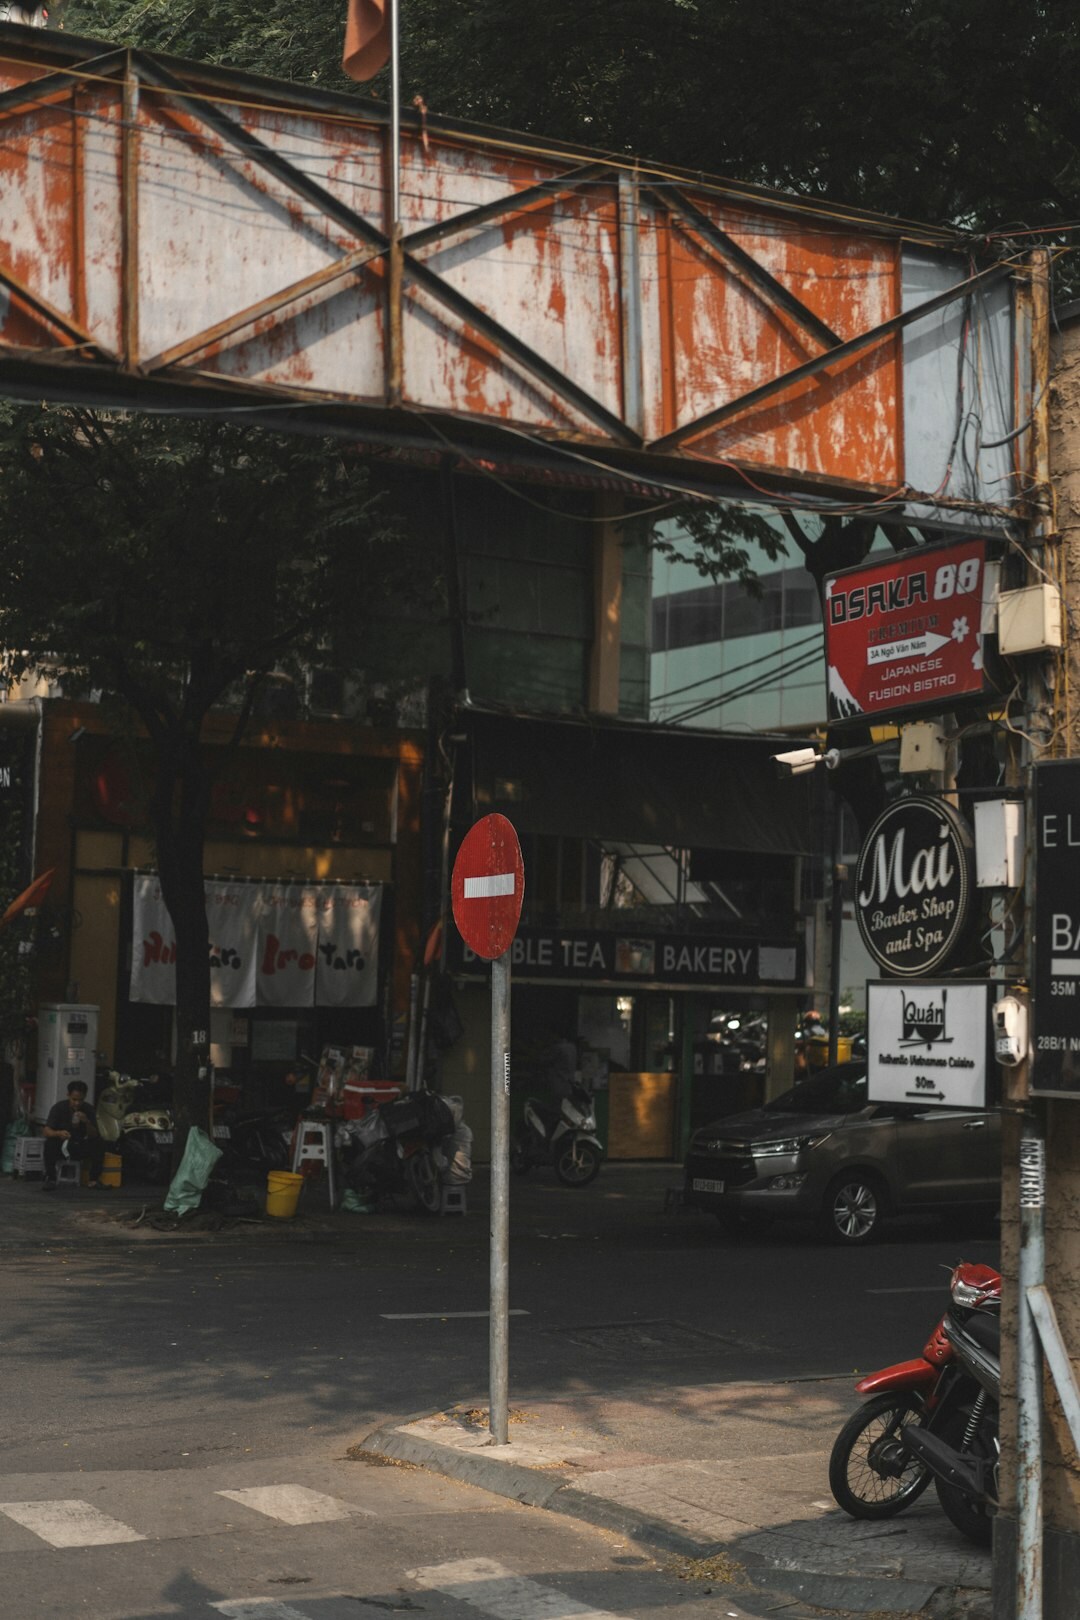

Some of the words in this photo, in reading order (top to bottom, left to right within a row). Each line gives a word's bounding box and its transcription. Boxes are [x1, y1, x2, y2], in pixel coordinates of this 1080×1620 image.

[829, 571, 928, 626] OSAKA
[933, 558, 980, 601] 88
[867, 612, 940, 643] PREMIUM
[881, 658, 943, 681] JAPANESE
[868, 683, 911, 702] FUSION
[914, 673, 956, 692] BISTRO
[859, 823, 954, 907] Mai
[871, 904, 919, 932] Barber
[921, 896, 955, 919] Shop
[885, 930, 912, 954] and
[914, 926, 944, 952] Spa
[561, 940, 606, 968] TEA
[663, 945, 753, 974] BAKERY
[1050, 981, 1076, 996] 35M
[905, 1001, 944, 1024] Quán
[192, 1030, 206, 1044] 18
[1037, 1035, 1067, 1050] 28B/1
